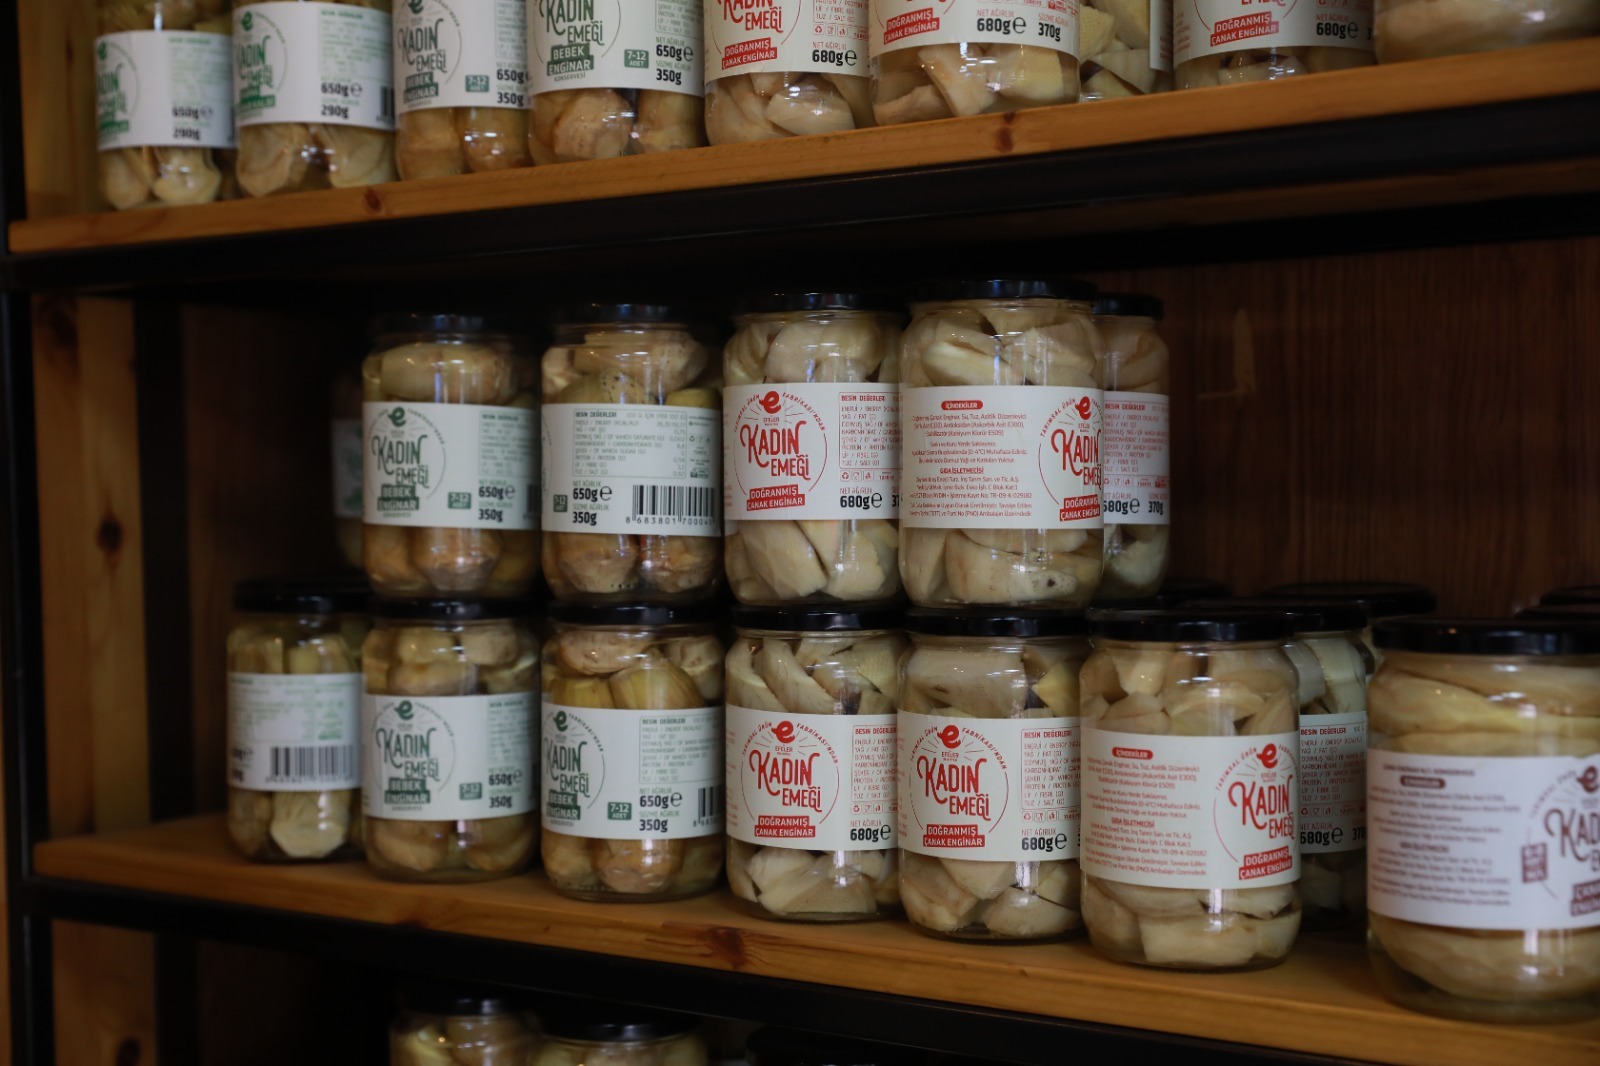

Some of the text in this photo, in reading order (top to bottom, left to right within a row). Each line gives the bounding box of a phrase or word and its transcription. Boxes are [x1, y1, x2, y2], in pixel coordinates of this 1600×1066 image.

[888, 10, 932, 30] DOĞRANMIŞ
[903, 20, 938, 35] ENGİNAR
[1215, 13, 1271, 33] DOĞRANMIŞ
[977, 18, 1061, 42] 680g 370g
[1211, 23, 1277, 46] ÇANAK ENGİNAR
[1316, 22, 1346, 39] 680g
[552, 45, 585, 59] BEBEK
[627, 51, 646, 60] 7-12
[656, 45, 682, 61] 650g
[725, 39, 770, 57] DOĞRANMIŞ
[742, 50, 775, 64] ENGİNAR
[812, 49, 844, 66] 680g
[549, 59, 591, 74] ENGİNAR
[496, 69, 524, 84] 650g
[656, 69, 682, 85] 350g
[321, 82, 348, 97] 650g
[497, 92, 524, 107] 350g
[321, 104, 348, 119] 290g
[740, 420, 807, 468] KADIN
[371, 434, 428, 475] KADIN
[1050, 428, 1102, 476] KADIN
[771, 454, 811, 480] EMEĞİ
[478, 486, 504, 500] 650g
[573, 488, 598, 502] 650g
[750, 486, 797, 500] DOĞRANMIŞ
[769, 497, 803, 508] ENGİNAR
[840, 495, 870, 510] 680g
[1148, 500, 1164, 516] 370g
[478, 508, 504, 522] 350g
[572, 511, 597, 526] 350g
[376, 727, 436, 769] KADIN
[962, 728, 1007, 770] FABRİKASI'NDAN
[489, 773, 513, 786] 650g
[748, 750, 820, 796] KADIN
[917, 755, 987, 804] KADIN
[489, 795, 513, 809] 350g
[639, 795, 669, 809] 650g
[782, 786, 823, 813] EMEĞİ
[1228, 774, 1293, 830] KADIN
[610, 804, 630, 812] 7-12
[950, 794, 991, 821] EMEĞİ
[639, 818, 668, 832] 350g
[759, 816, 808, 827] DOĞRANMIŞ
[755, 826, 814, 838] ÇANAK ENGİNAR
[850, 828, 879, 842] 680g
[928, 824, 977, 836] DOĞRANMIŞ
[1300, 828, 1367, 846] 680g 370
[1544, 808, 1600, 862] KAD
[924, 835, 982, 846] ÇANAK ENGİNAR
[1022, 837, 1053, 852] 680g
[1246, 850, 1289, 866] DOĞRANMIŞ
[1240, 866, 1266, 879] ÇANAK
